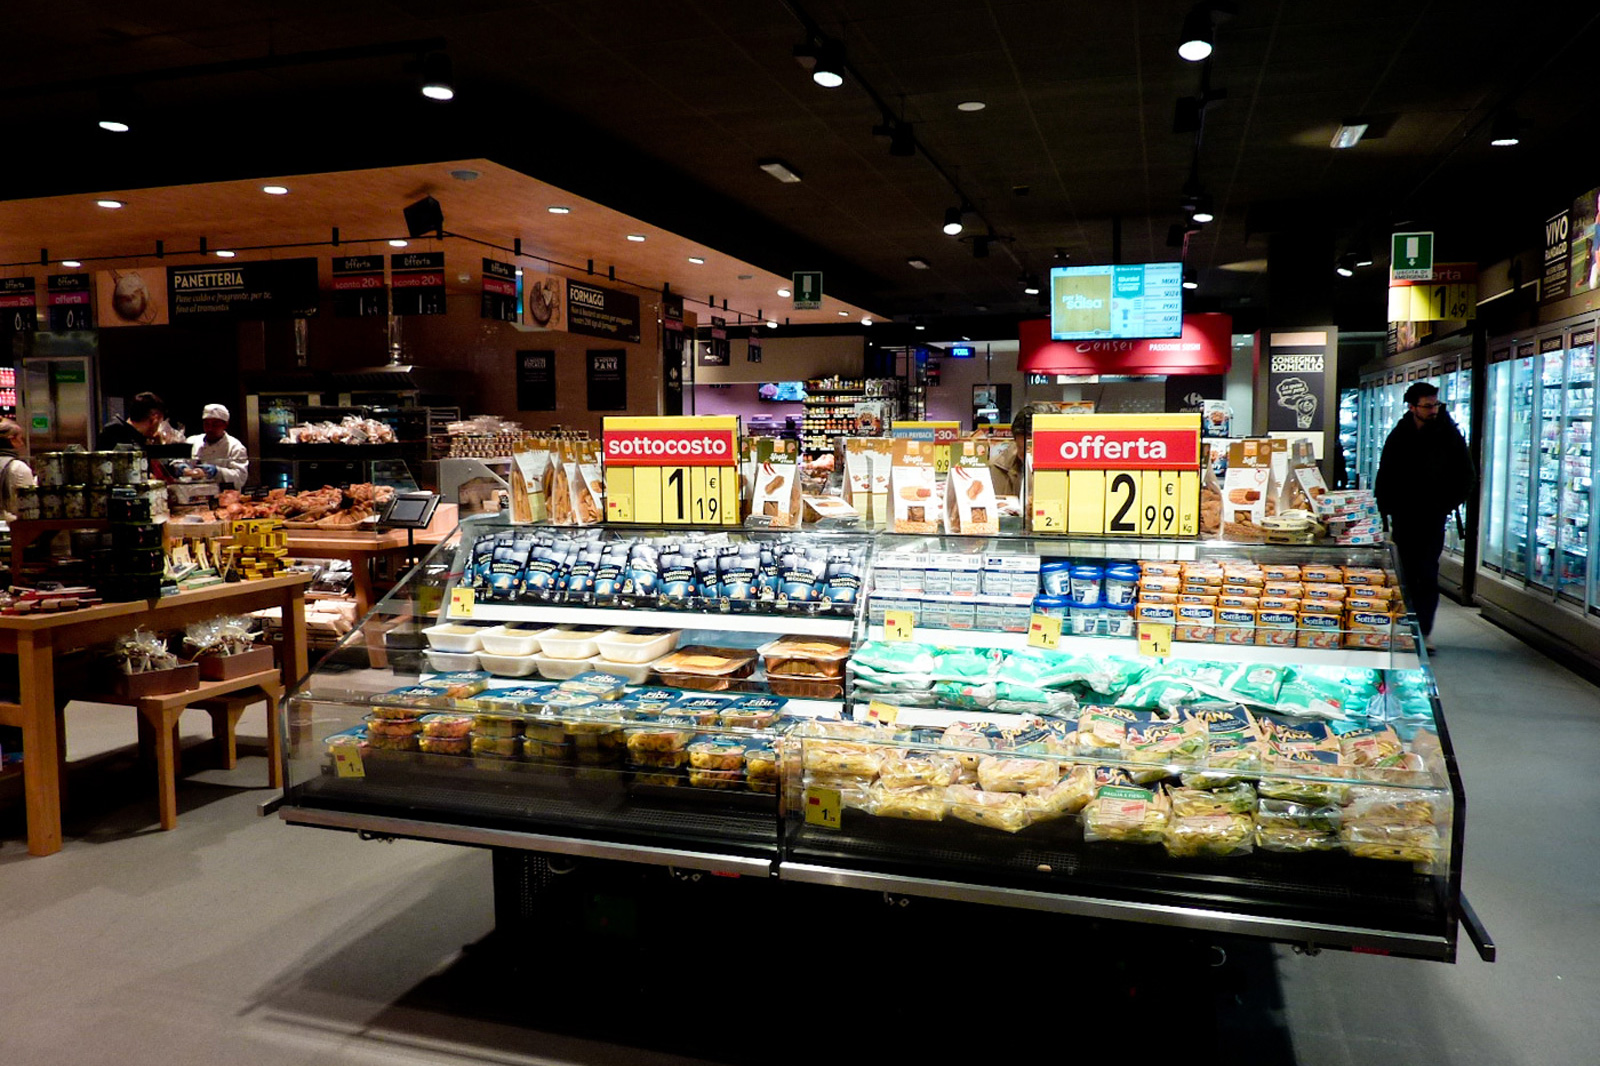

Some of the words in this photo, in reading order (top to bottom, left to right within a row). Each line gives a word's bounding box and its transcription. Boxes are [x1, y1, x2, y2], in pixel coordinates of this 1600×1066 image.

[1432, 269, 1462, 280] erta
[174, 272, 244, 288] PANETTERIA
[570, 288, 604, 306] FORMAGGI
[1434, 286, 1446, 318] 1
[1451, 304, 1466, 318] 49
[1272, 356, 1316, 364] CONSEGNA
[1317, 356, 1324, 364] A
[1272, 363, 1324, 371] DOMICILIO
[608, 436, 727, 456] sottocosto
[1059, 434, 1167, 460] offerta
[936, 460, 950, 470] 99
[709, 478, 716, 488] €
[668, 468, 684, 520] 1
[1165, 483, 1174, 496] €
[1110, 473, 1136, 531] 2
[696, 498, 718, 520] 19
[1045, 516, 1052, 526] 2
[1145, 505, 1174, 530] 99
[1141, 608, 1172, 618] Sottilette
[1180, 608, 1211, 618] Sottilette
[1220, 612, 1252, 622] Sottilette
[1260, 614, 1292, 622] Sottilette
[1304, 617, 1336, 626] Sottilette
[1355, 614, 1388, 624] Sottilette
